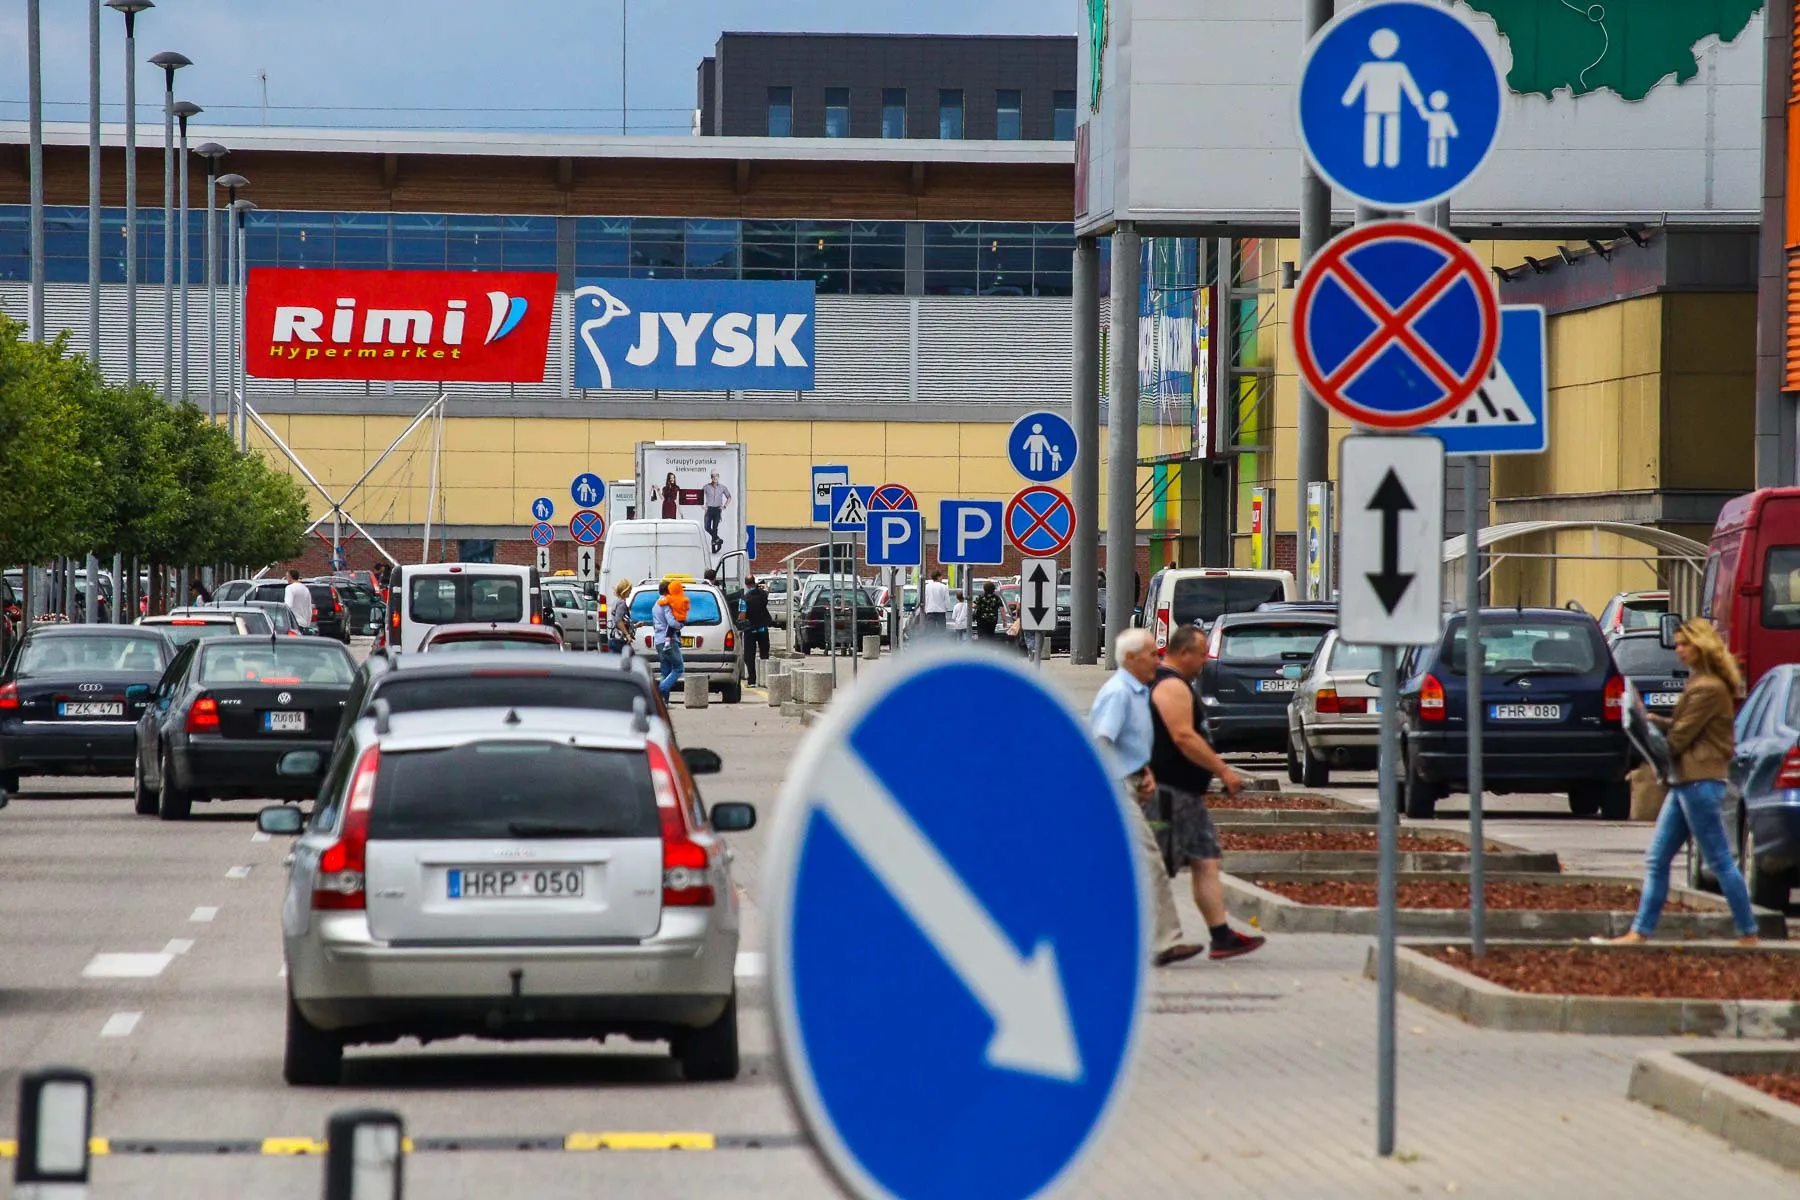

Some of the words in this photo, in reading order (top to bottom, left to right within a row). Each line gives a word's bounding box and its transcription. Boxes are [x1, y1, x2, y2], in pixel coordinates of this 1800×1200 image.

[272, 297, 468, 344] Rimi
[625, 312, 808, 367] JYSK
[269, 345, 461, 360] Hypermarket
[882, 517, 912, 559] P
[957, 507, 992, 556] P
[1262, 680, 1285, 690] EOH
[1651, 693, 1676, 704] GCC
[66, 703, 91, 715] FZK
[99, 703, 121, 714] 471
[1499, 705, 1526, 717] FHR
[1534, 705, 1558, 717] 080
[463, 871, 516, 895] HRP
[534, 871, 579, 893] 050
